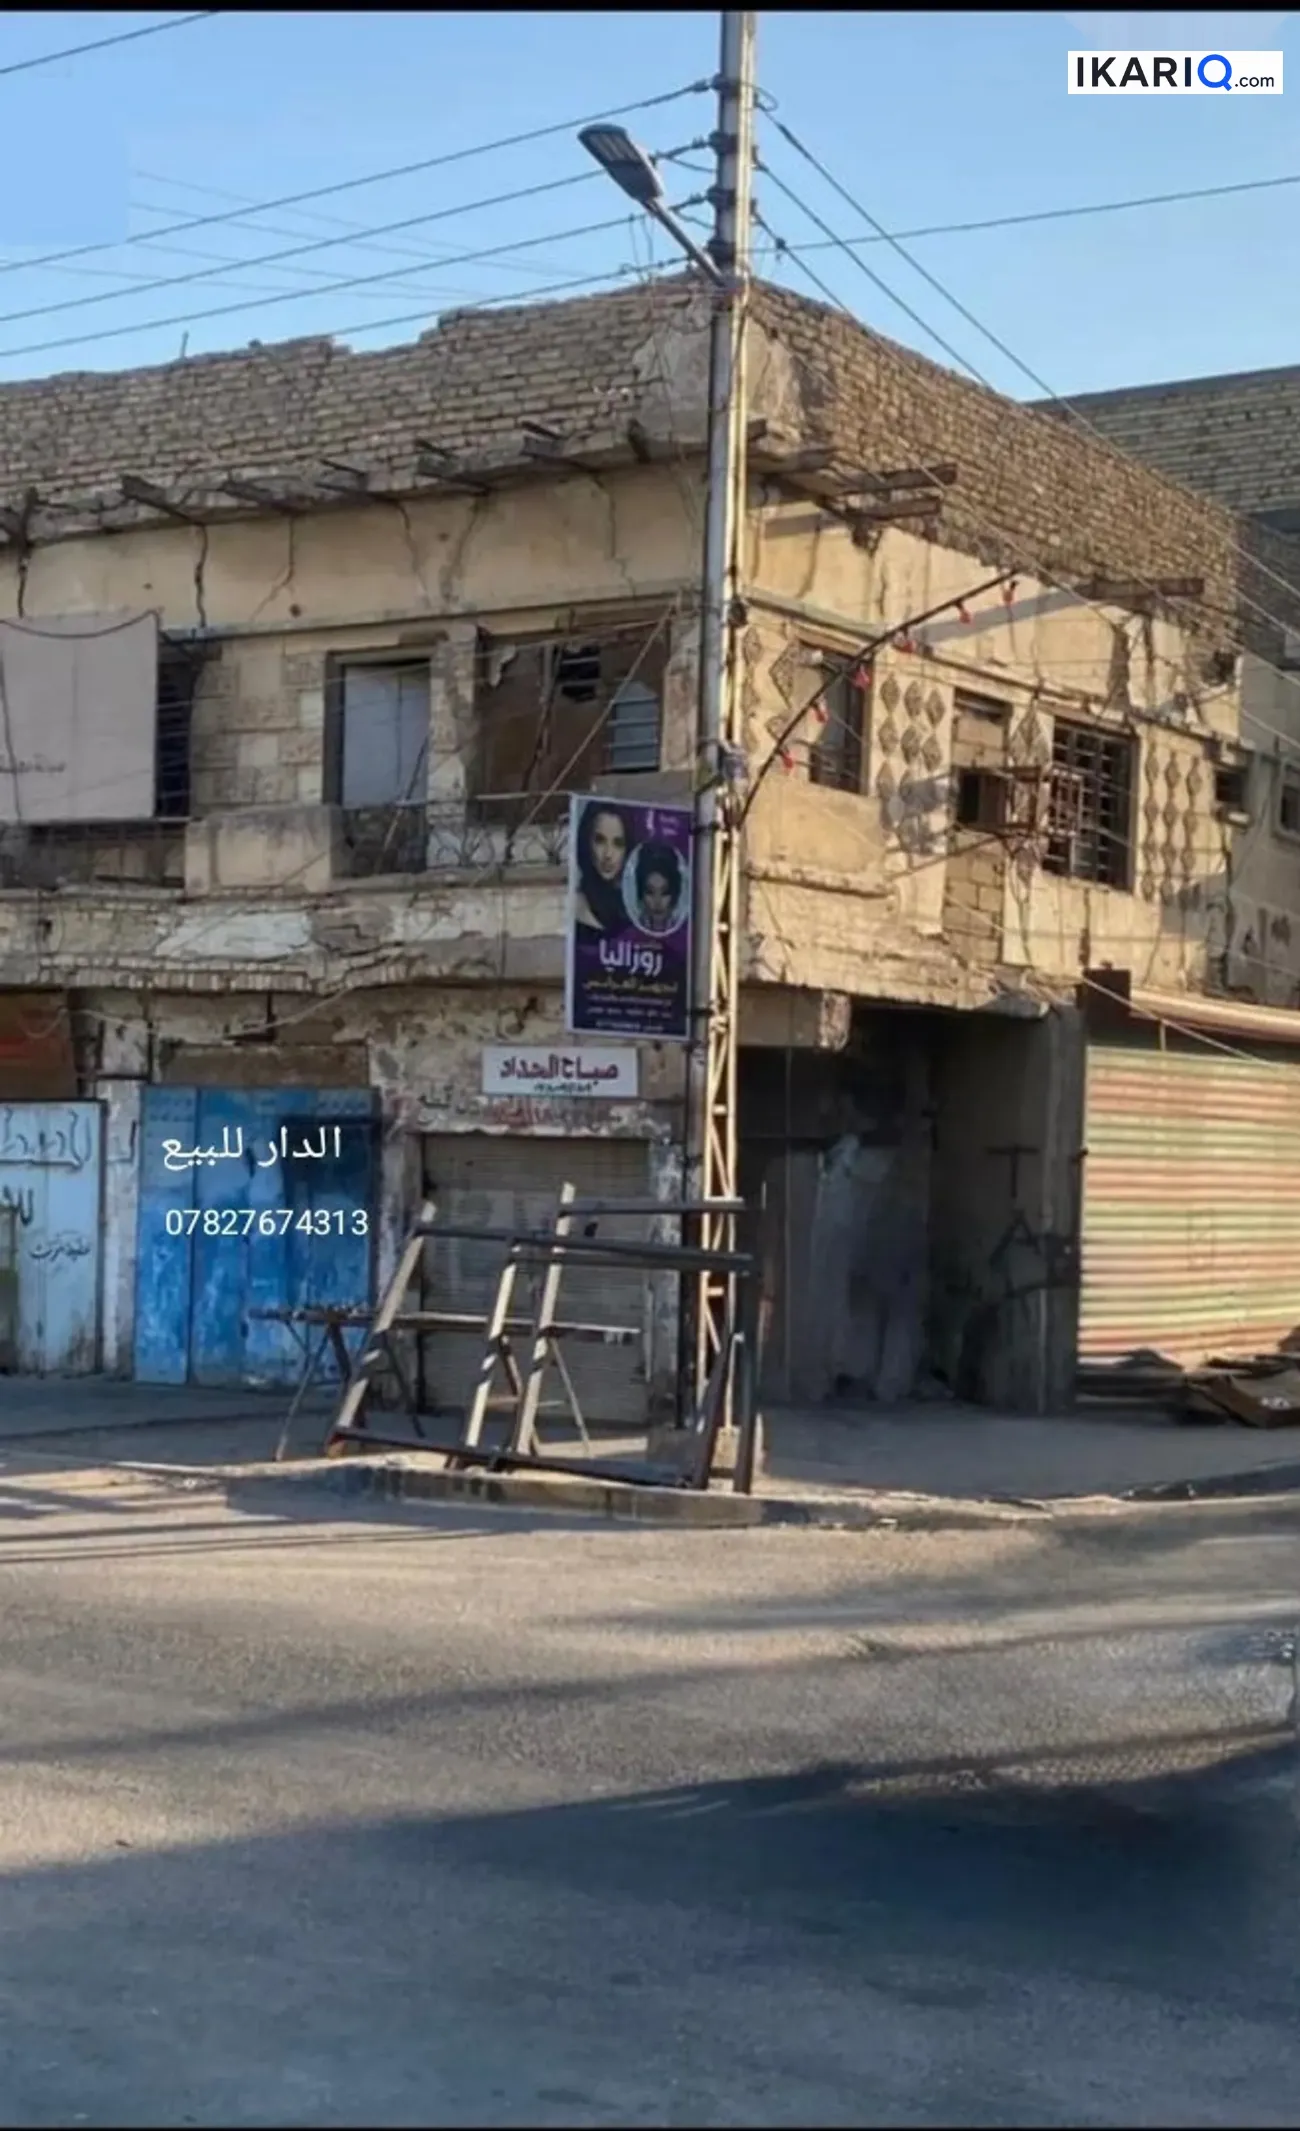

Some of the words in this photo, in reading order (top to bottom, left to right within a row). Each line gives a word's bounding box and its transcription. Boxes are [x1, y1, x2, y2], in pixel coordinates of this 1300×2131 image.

[599, 938, 664, 978] روزاليا
[499, 1053, 560, 1080] الحداد
[562, 1055, 619, 1086] صباح
